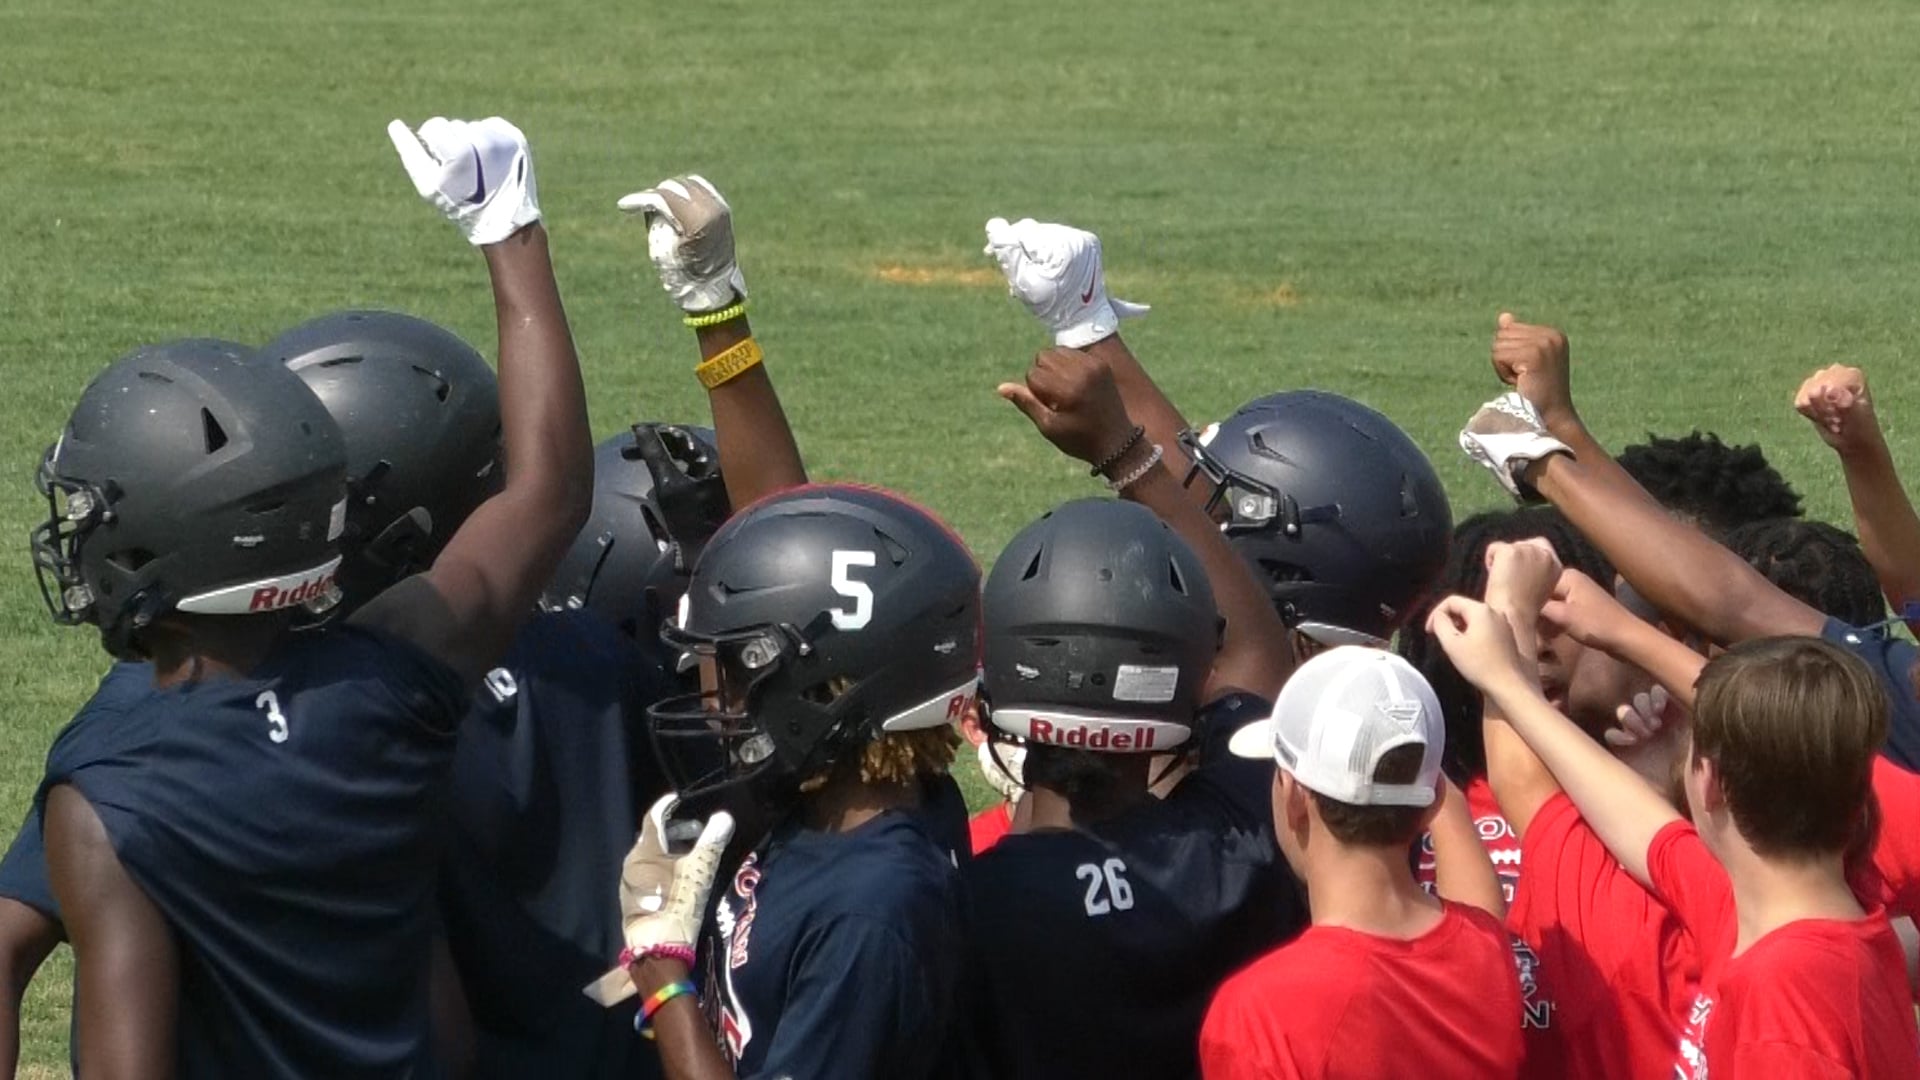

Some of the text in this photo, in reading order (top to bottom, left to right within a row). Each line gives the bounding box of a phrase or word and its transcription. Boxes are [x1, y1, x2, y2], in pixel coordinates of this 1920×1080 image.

[831, 550, 876, 631] 5
[256, 690, 288, 743] 3
[1029, 717, 1155, 750] Riddell
[1076, 858, 1134, 916] 26
